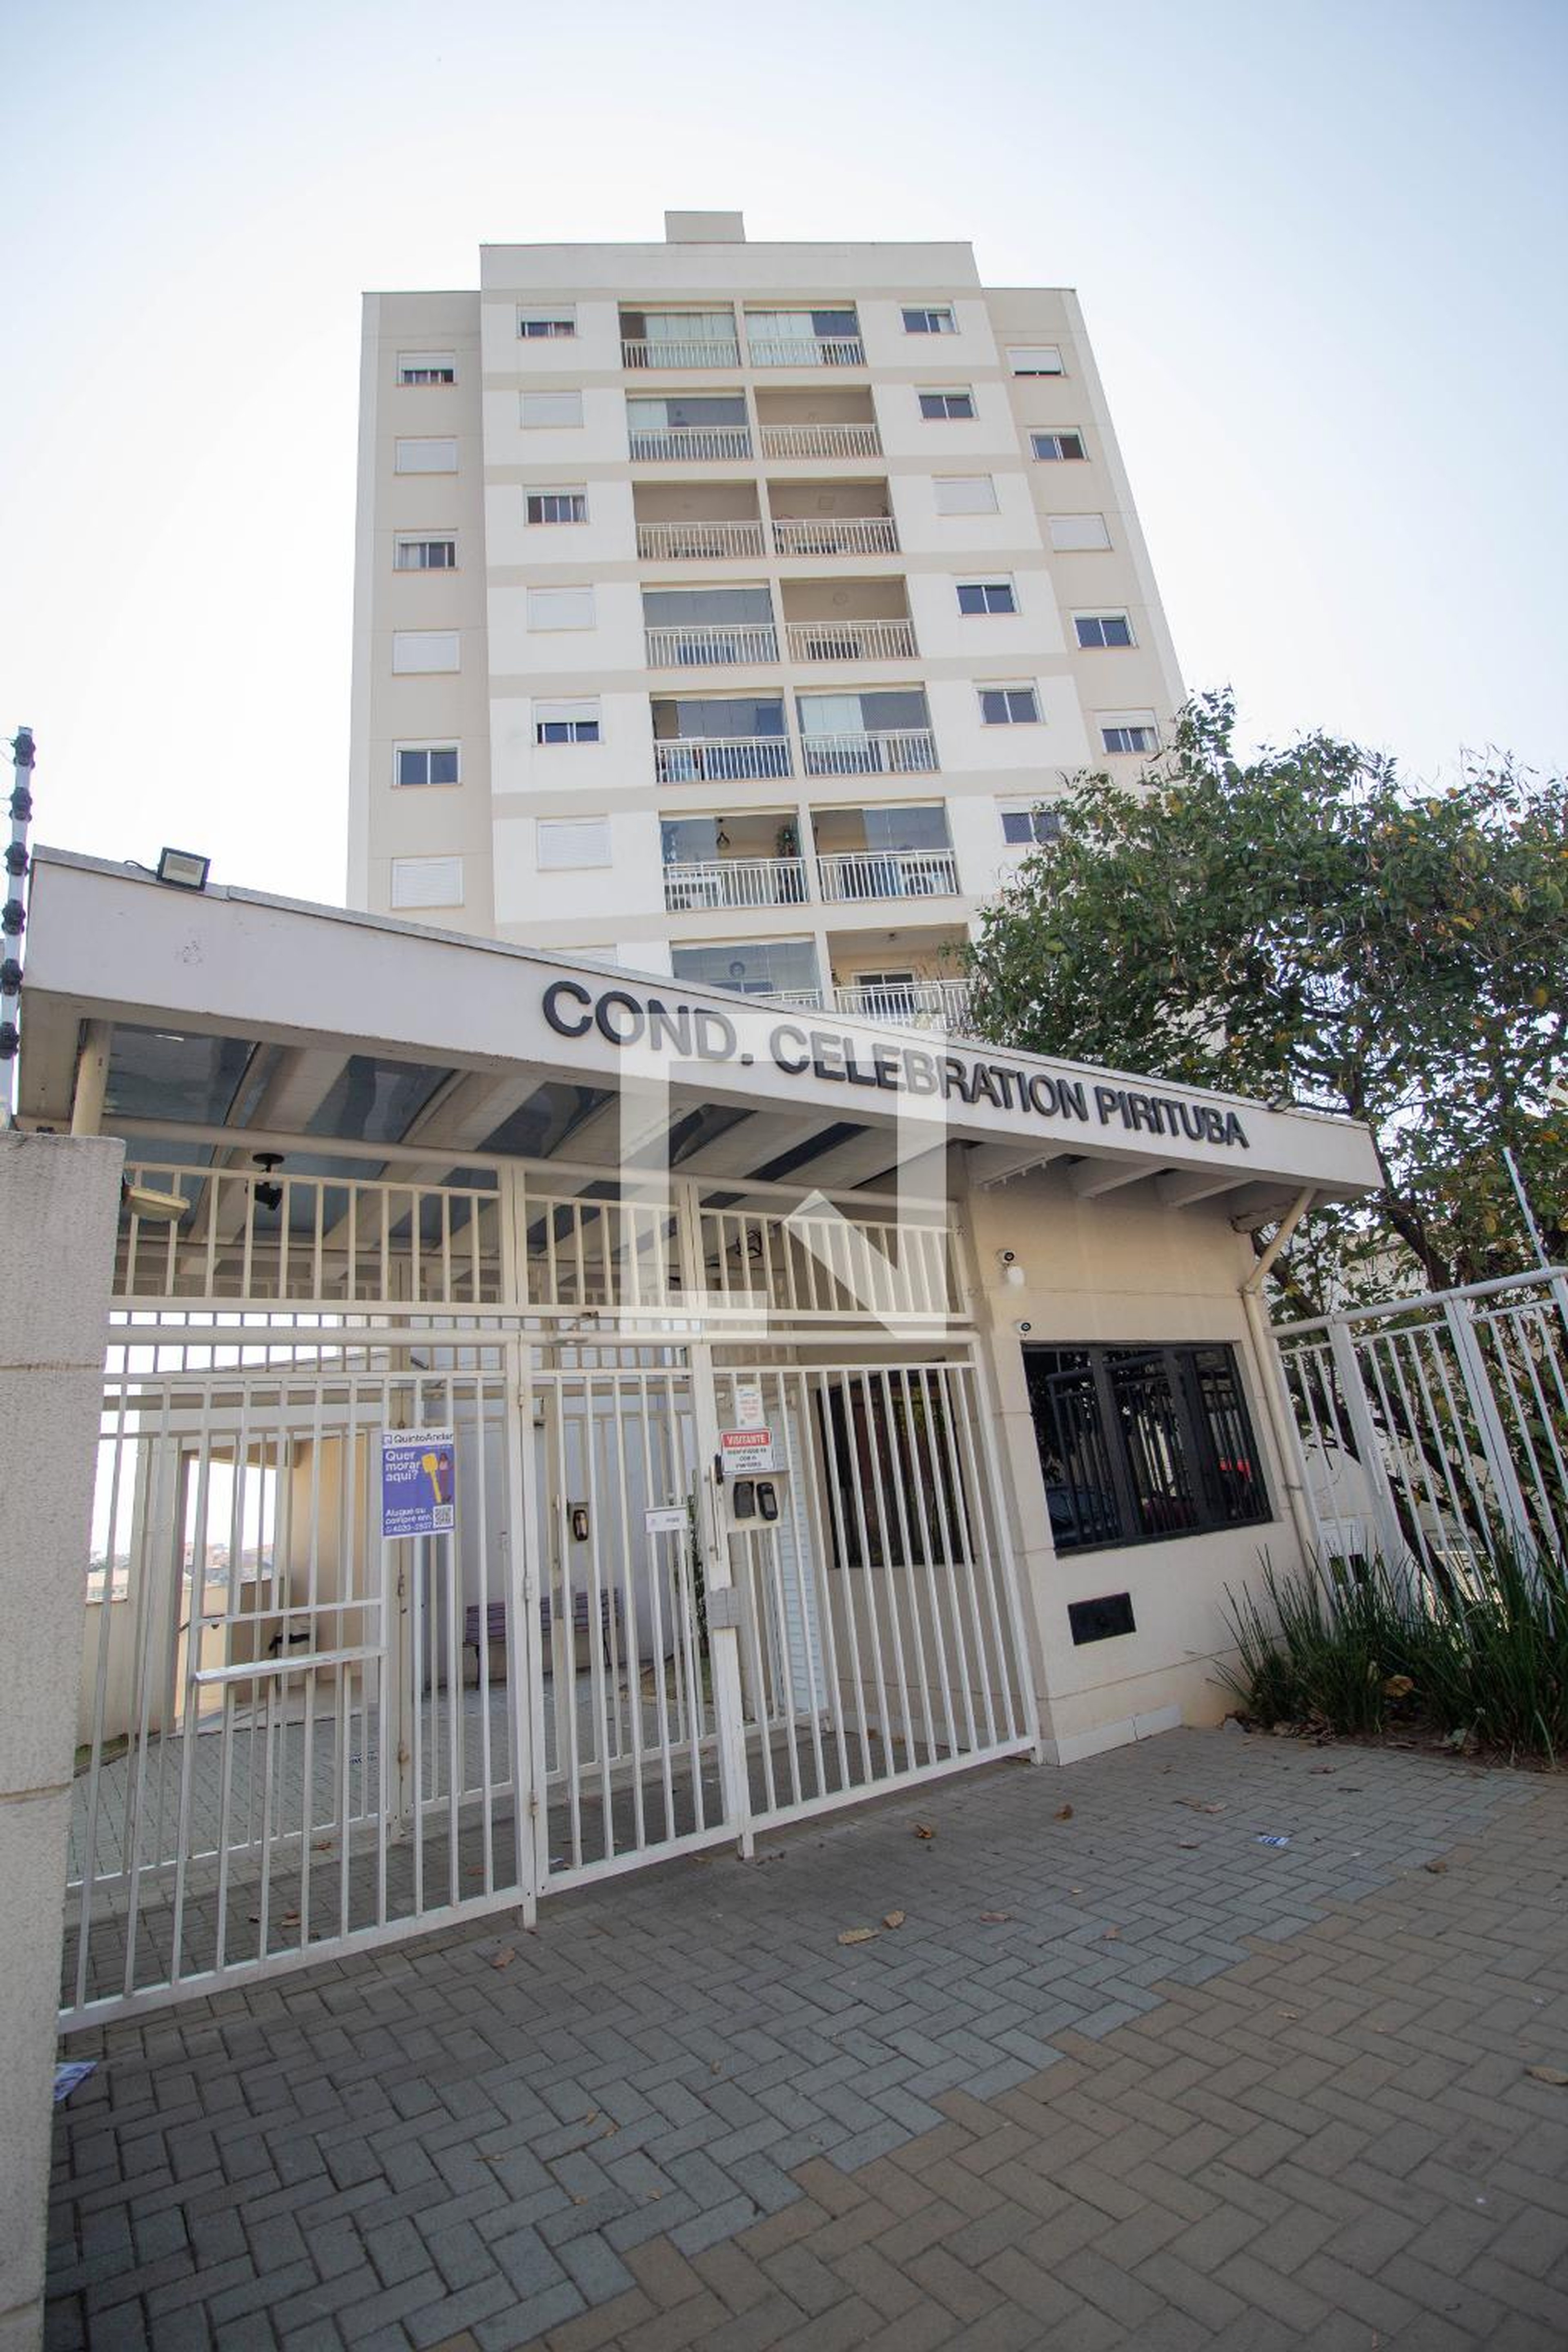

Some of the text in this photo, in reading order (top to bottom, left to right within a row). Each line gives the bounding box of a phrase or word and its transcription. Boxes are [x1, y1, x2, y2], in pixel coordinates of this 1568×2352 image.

[542, 981, 1250, 1148] COND. CELEBRATION PIRITUBA
[394, 1432, 453, 1443] QuintoAndar
[727, 1434, 766, 1446] VISITANTE
[385, 1451, 416, 1462] Quer
[385, 1461, 421, 1471] morar
[385, 1470, 419, 1482] aqui?
